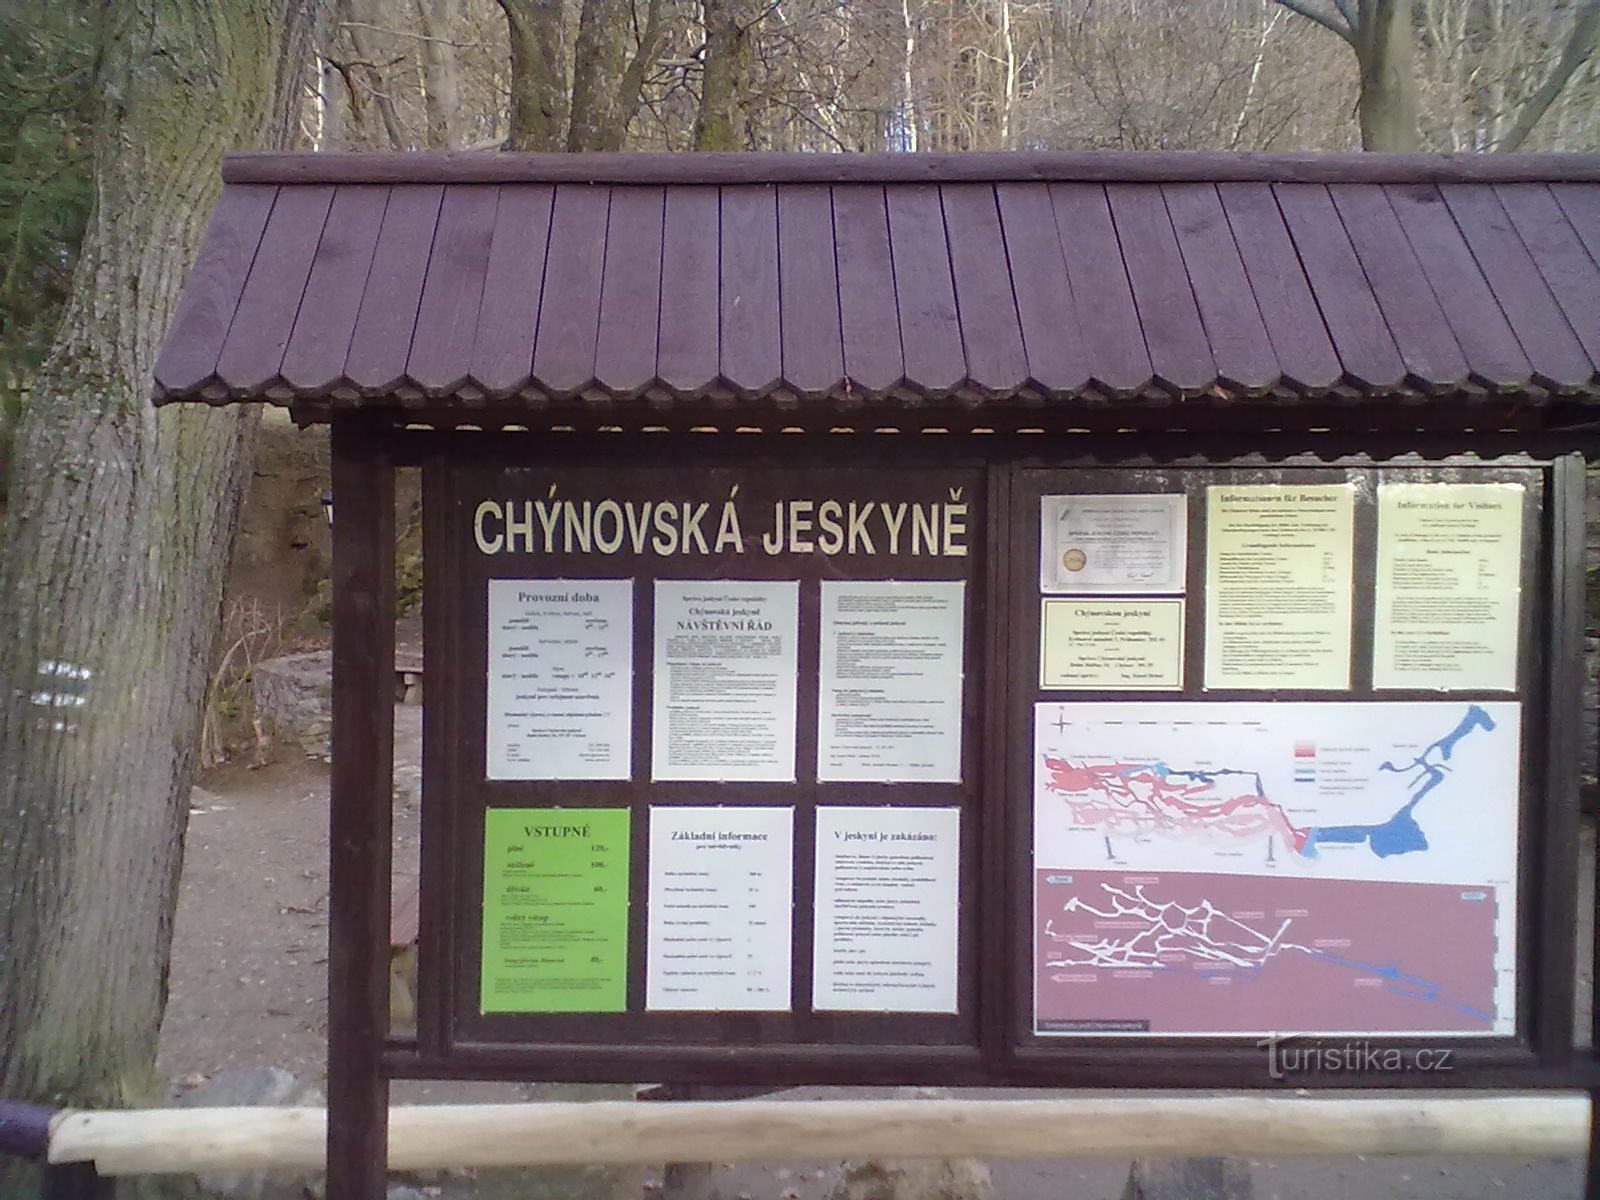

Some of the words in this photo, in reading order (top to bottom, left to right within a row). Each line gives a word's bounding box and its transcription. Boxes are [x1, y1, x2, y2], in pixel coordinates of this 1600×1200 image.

[474, 483, 744, 555] CHÝNOVSKÁ
[761, 487, 968, 556] JESKYNĚ
[518, 592, 569, 602] Provozní
[571, 592, 600, 602] doba
[677, 619, 744, 631] NÁVŠTĚVNÍ
[747, 618, 773, 631] ŘÁD
[524, 824, 592, 837] VSTUPNÉ
[671, 831, 716, 841] Základní
[718, 831, 768, 841] informace
[834, 831, 842, 839] V
[879, 832, 889, 842] je
[890, 832, 938, 842] zakázáno:
